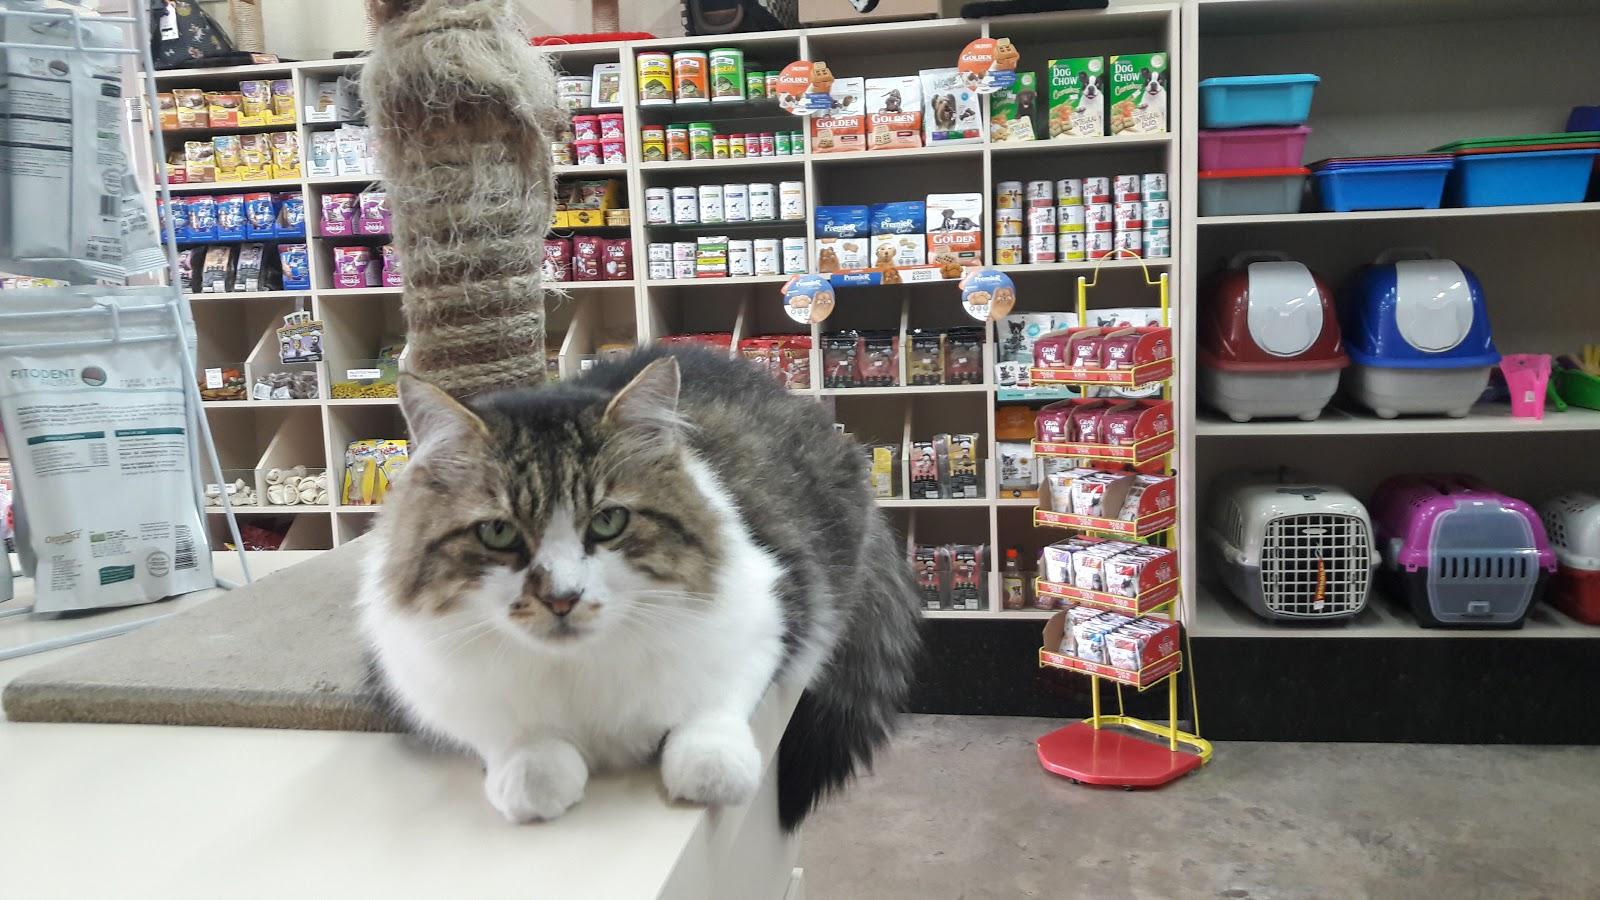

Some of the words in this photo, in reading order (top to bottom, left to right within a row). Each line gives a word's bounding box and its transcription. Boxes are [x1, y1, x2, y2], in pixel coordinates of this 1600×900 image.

[1053, 68, 1071, 77] DOG
[1115, 64, 1133, 73] DOG
[1052, 76, 1078, 86] CHOW
[1114, 73, 1140, 82] CHOW
[816, 117, 859, 129] GOLDEN
[871, 112, 915, 124] GOLDEN
[933, 233, 976, 244] GOLDEN
[11, 368, 76, 379] FITODENT
